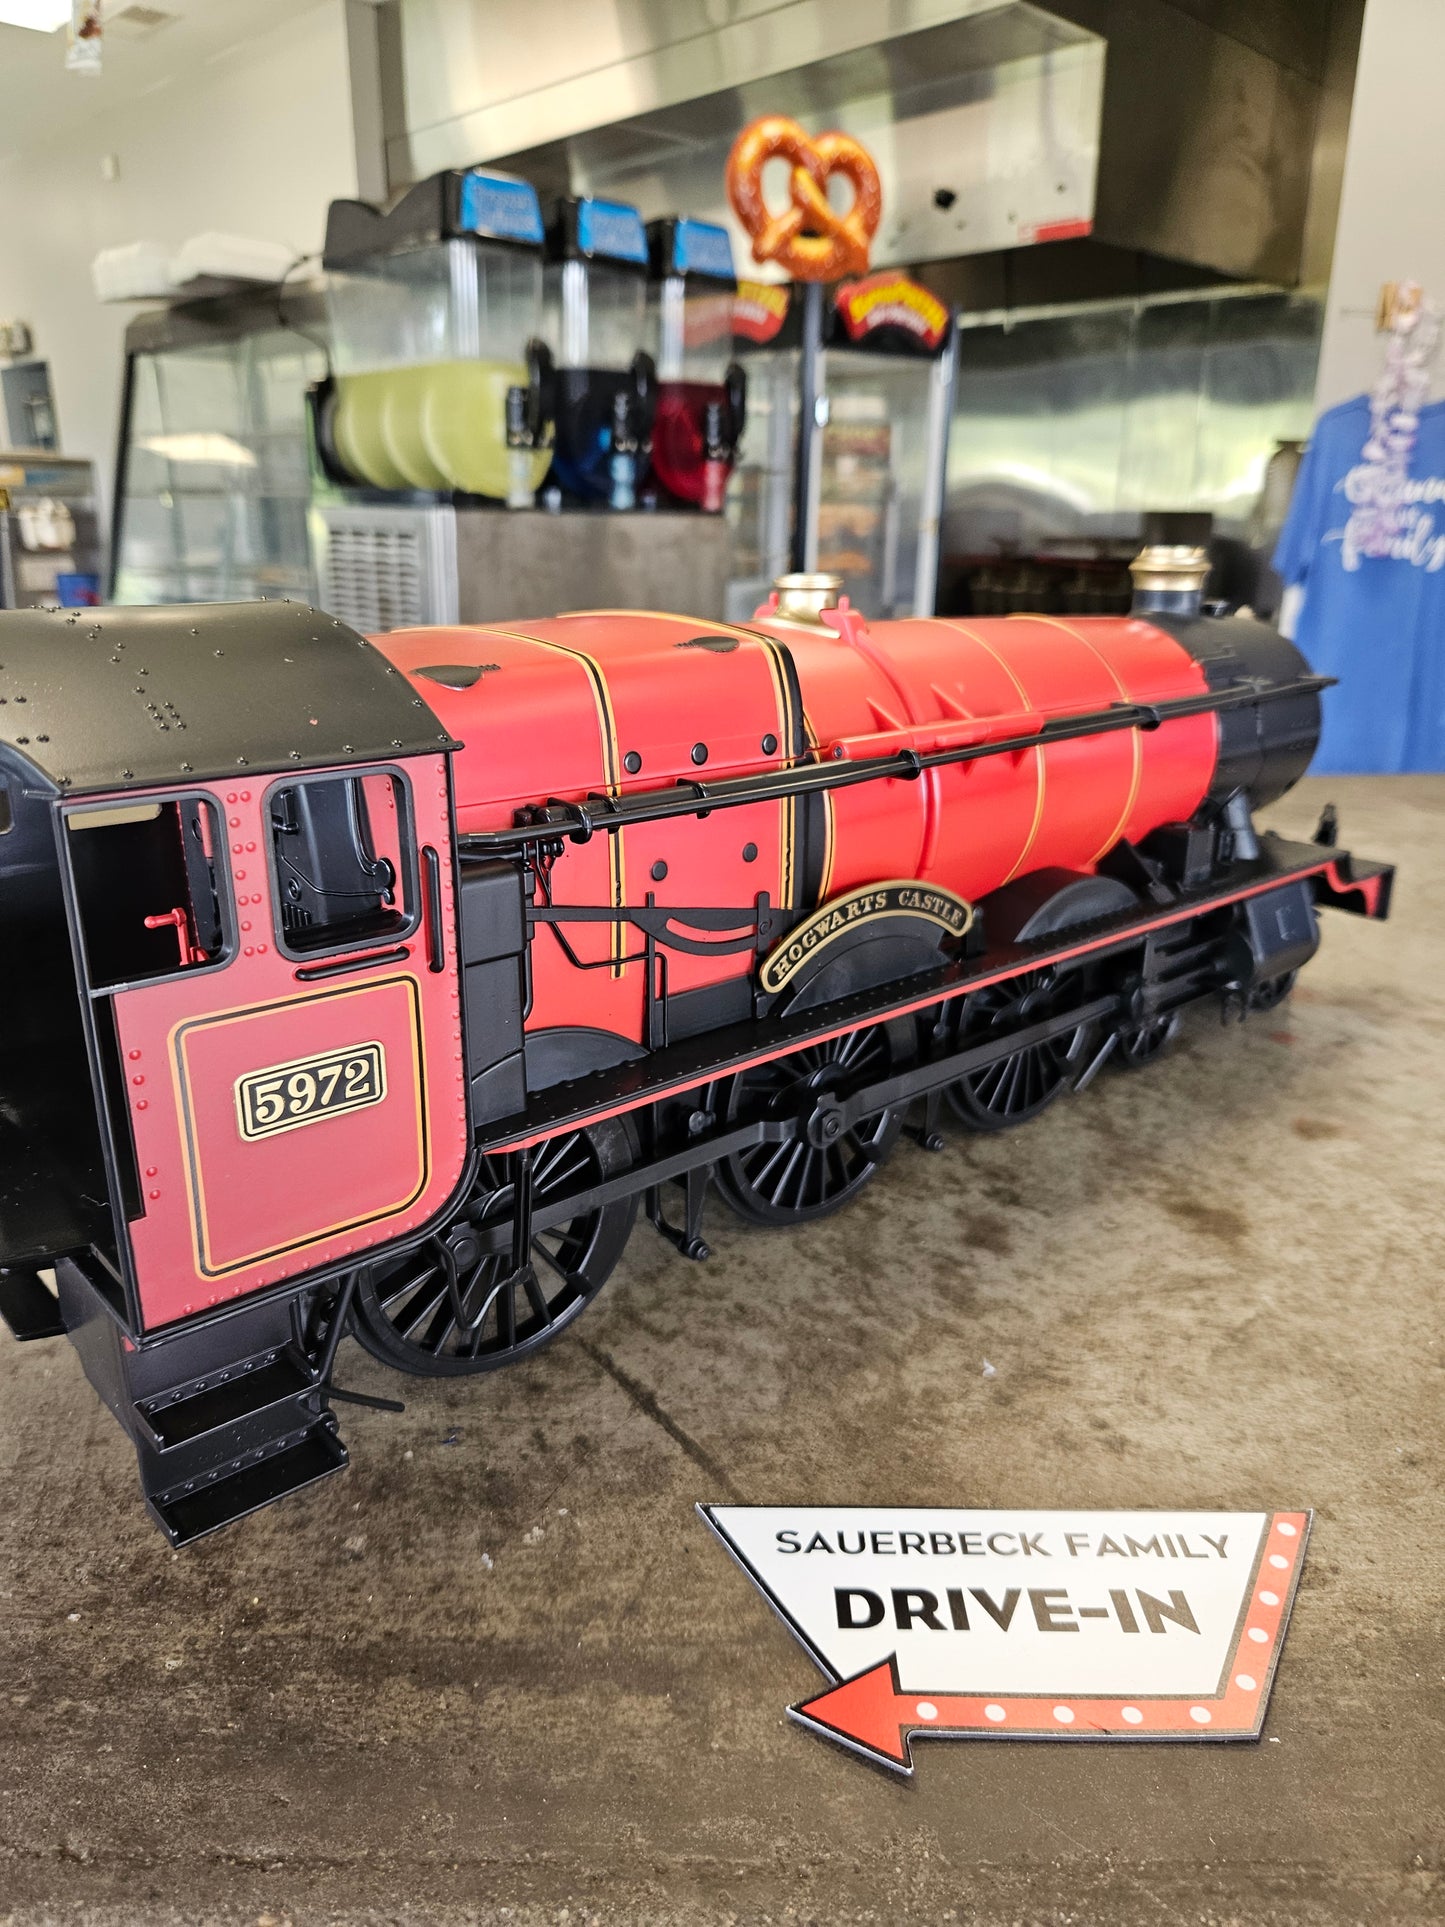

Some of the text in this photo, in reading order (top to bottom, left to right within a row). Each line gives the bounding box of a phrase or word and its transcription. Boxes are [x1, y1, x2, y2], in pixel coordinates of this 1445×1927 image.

[771, 888, 966, 981] HOGWARTS CASTLE
[255, 1058, 371, 1125] 5972
[775, 1529, 1229, 1559] SAUERBECK FAMILY
[833, 1586, 1202, 1636] DRIVE-IN
